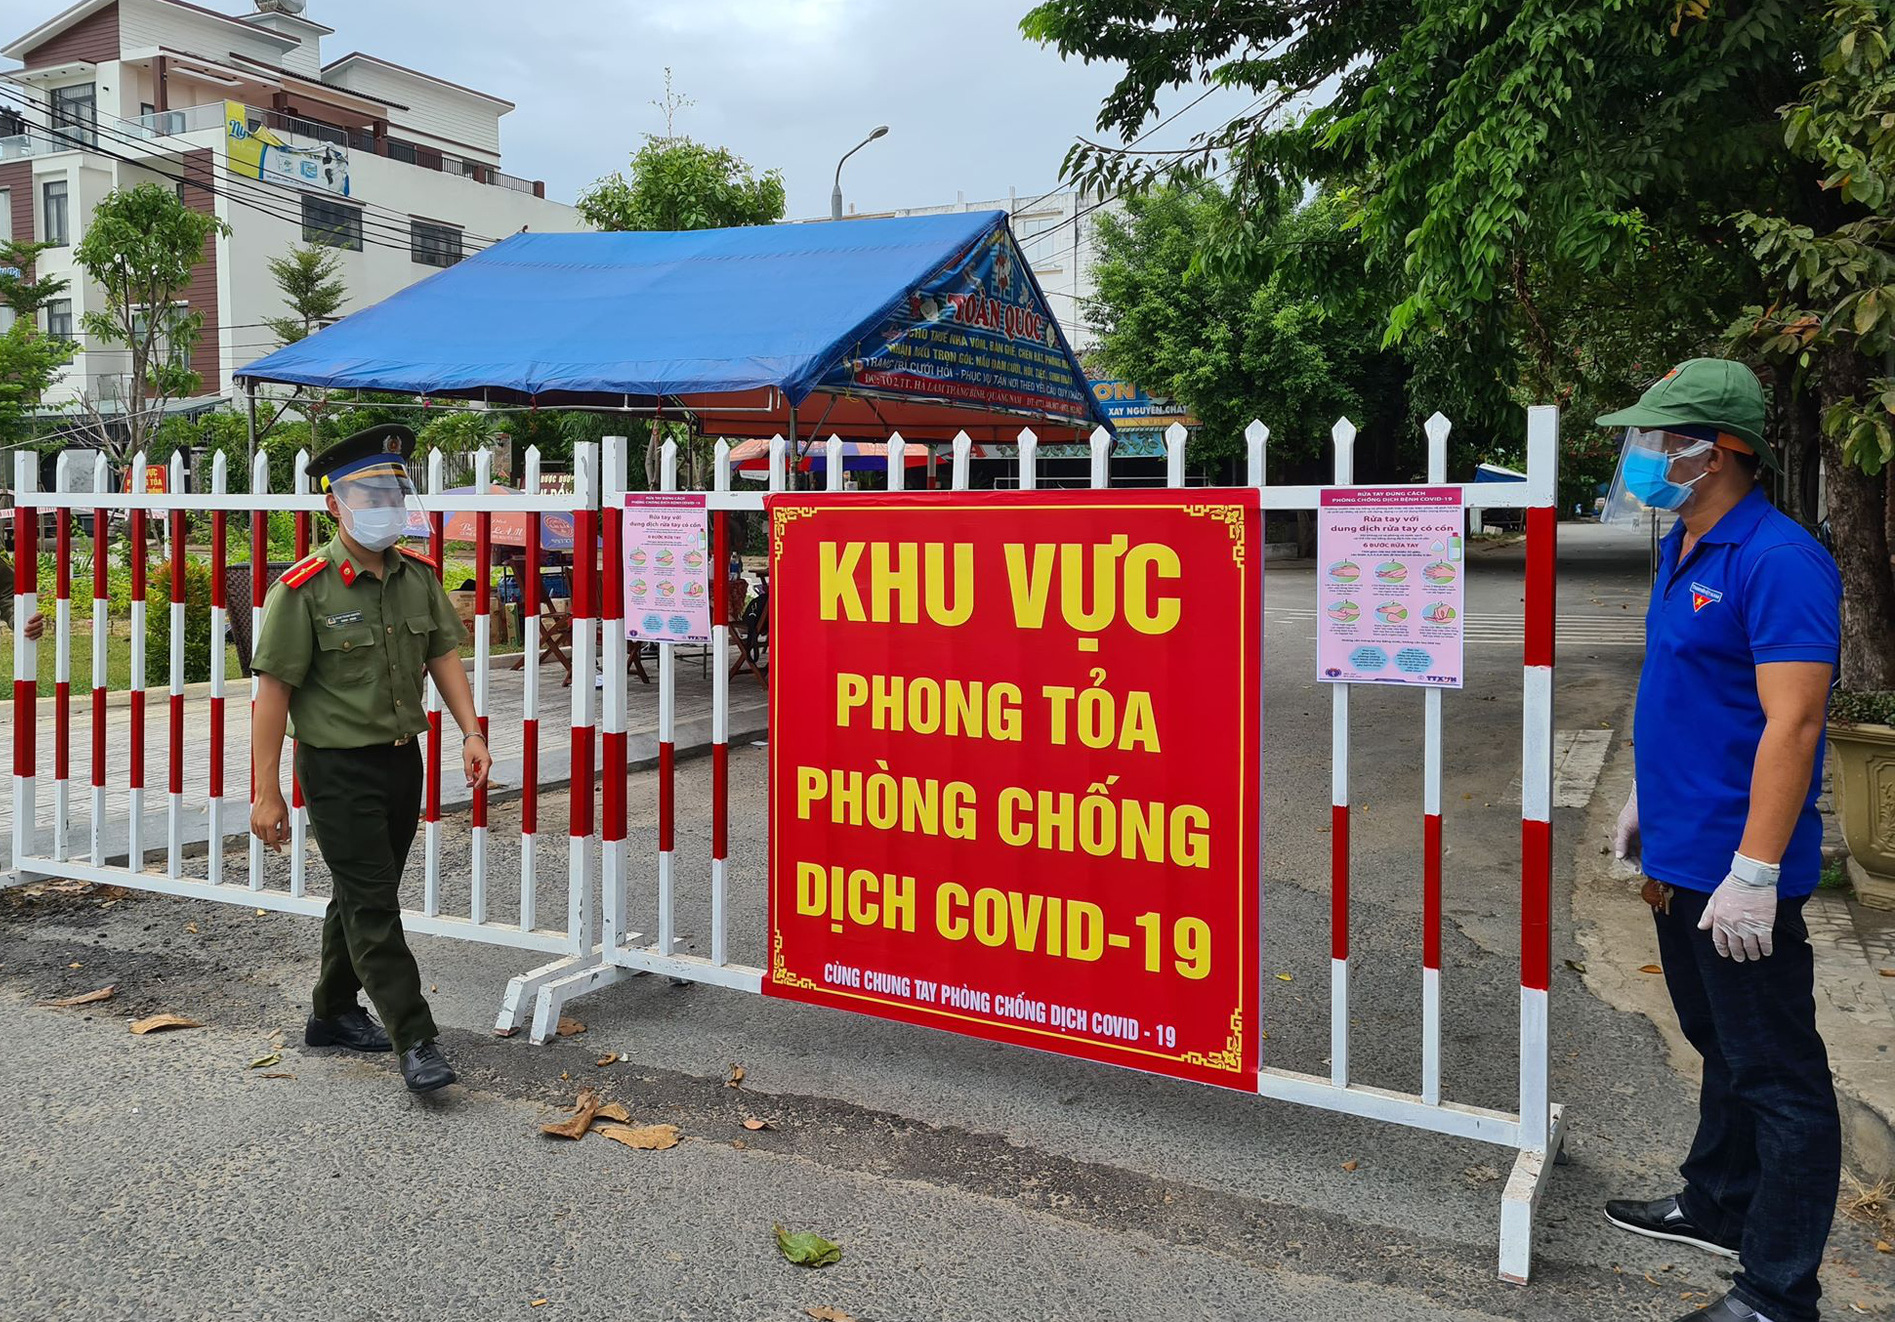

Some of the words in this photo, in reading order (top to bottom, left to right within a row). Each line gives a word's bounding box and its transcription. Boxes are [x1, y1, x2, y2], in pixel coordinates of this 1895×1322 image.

[947, 287, 1002, 331] TOÀN
[1004, 298, 1043, 341] QUỐC
[1109, 407, 1125, 416] XAY
[1331, 525, 1357, 533] dung
[1359, 525, 1381, 533] dịch
[1382, 524, 1400, 532] rửa
[1402, 525, 1418, 533] tay
[1420, 524, 1433, 532] có
[1403, 514, 1419, 522] với
[819, 541, 974, 627] KHU
[1003, 534, 1181, 652] VỰC
[836, 672, 1022, 742] PHONG
[1042, 667, 1161, 753] TỎA
[797, 760, 977, 841] PHÒNG
[998, 775, 1210, 869] CHỐNG
[796, 861, 916, 934] DỊCH
[935, 882, 1211, 980] COVID-19
[824, 961, 861, 989] CÙNG
[864, 970, 911, 998] CHUNG
[914, 979, 937, 1003] TAY
[941, 983, 991, 1014] PHÒNG
[994, 991, 1046, 1024] CHỐNG
[1050, 1004, 1087, 1032] DỊCH
[1091, 1012, 1139, 1041] COVID
[1156, 1024, 1176, 1048] 19
